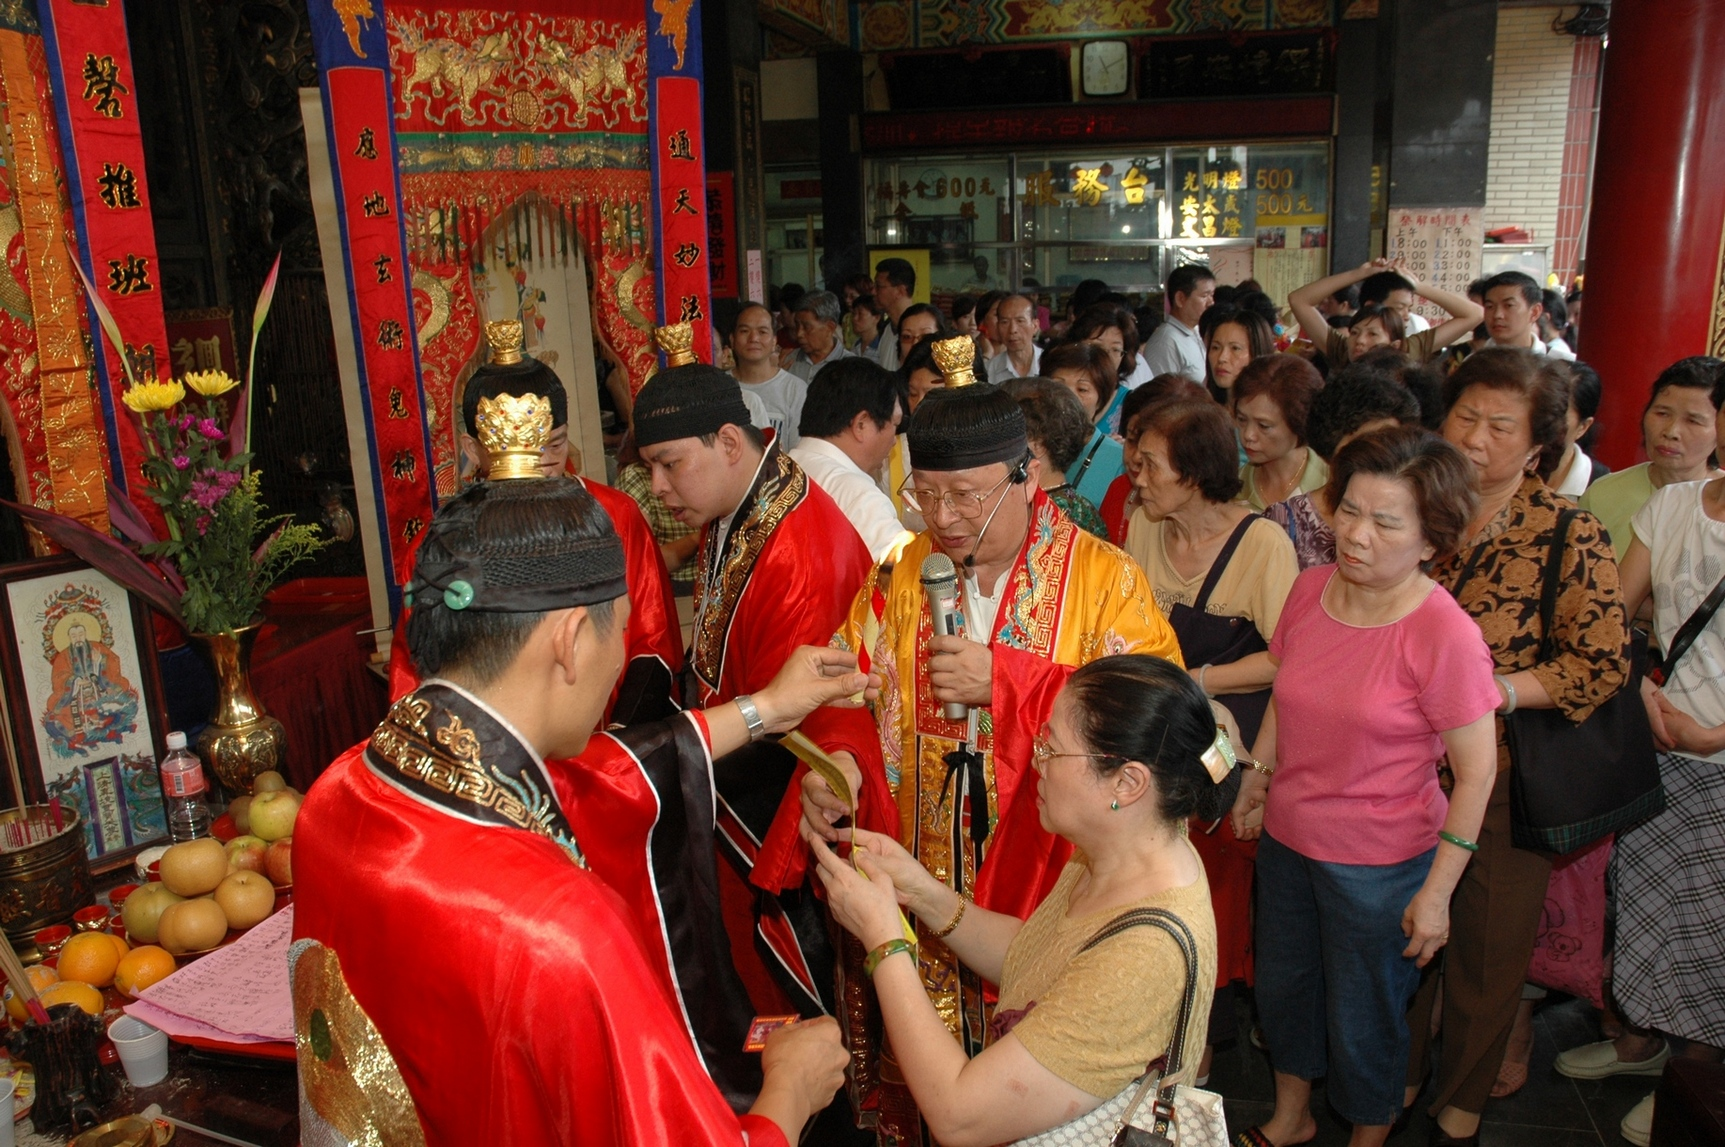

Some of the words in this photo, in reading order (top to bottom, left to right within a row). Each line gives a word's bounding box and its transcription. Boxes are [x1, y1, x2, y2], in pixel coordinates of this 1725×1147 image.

[1183, 170, 1242, 192] 光明燈
[1256, 168, 1293, 190] 500
[1025, 167, 1148, 206] 服務台
[1180, 194, 1240, 216] 安太歲
[669, 129, 703, 323] 通天妙法
[1180, 215, 1242, 238] 文昌燈
[1396, 227, 1418, 237] 上午
[1442, 227, 1463, 237] 下午
[1398, 237, 1427, 249] 8:00
[1444, 238, 1472, 249] 1:00
[1442, 250, 1471, 260] 2:00
[1441, 261, 1470, 270] 3:00
[1440, 273, 1470, 283] 4:00
[1416, 306, 1446, 316] 9:30
